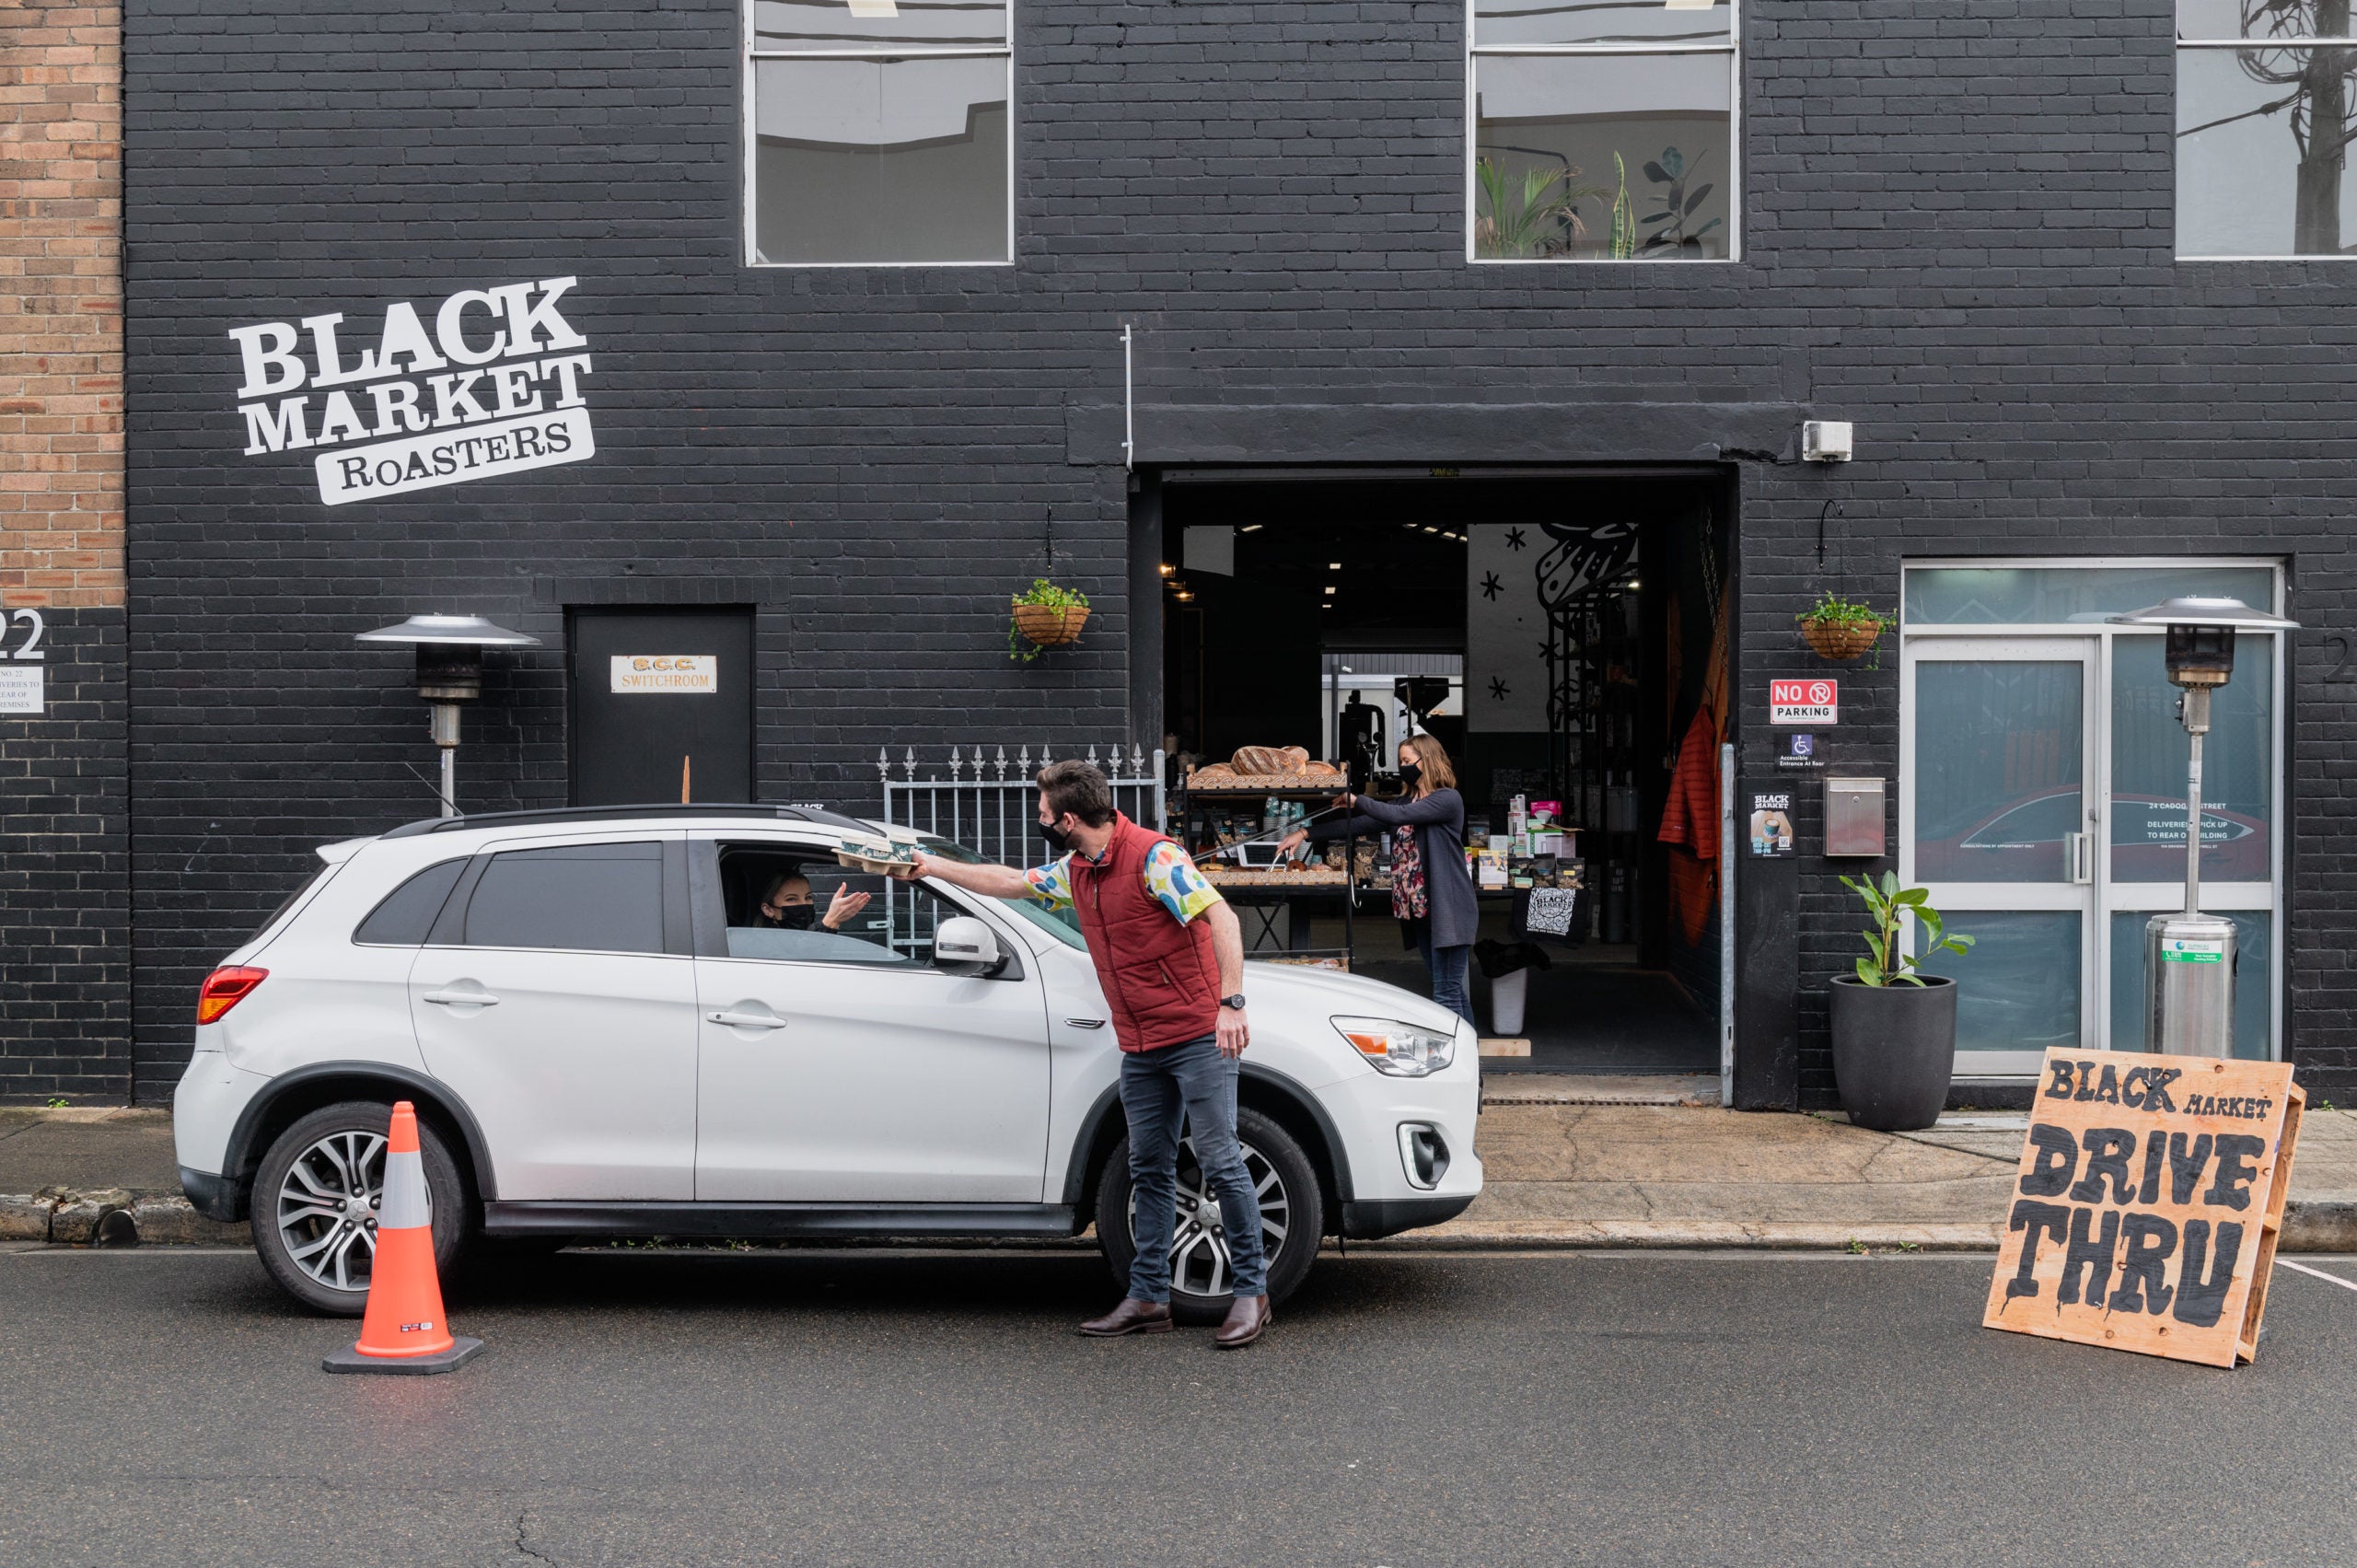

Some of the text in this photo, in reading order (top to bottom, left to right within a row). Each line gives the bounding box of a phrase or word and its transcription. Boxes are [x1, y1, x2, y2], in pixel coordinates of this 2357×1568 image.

[228, 276, 587, 399] BLACK
[238, 354, 592, 456] MARKET
[337, 422, 572, 490] ROASTERS
[0, 609, 44, 659] 2
[621, 675, 709, 687] SWITCHROOM
[633, 657, 696, 671] S.C.C.
[1775, 685, 1802, 702] NO
[1777, 707, 1829, 716] PARKING
[1754, 795, 1789, 803] BLACK
[1537, 896, 1566, 904] BLACK
[2045, 1060, 2271, 1120] BLACK MARKET
[2020, 1123, 2265, 1212] DRIVE
[2005, 1200, 2244, 1328] THRU
